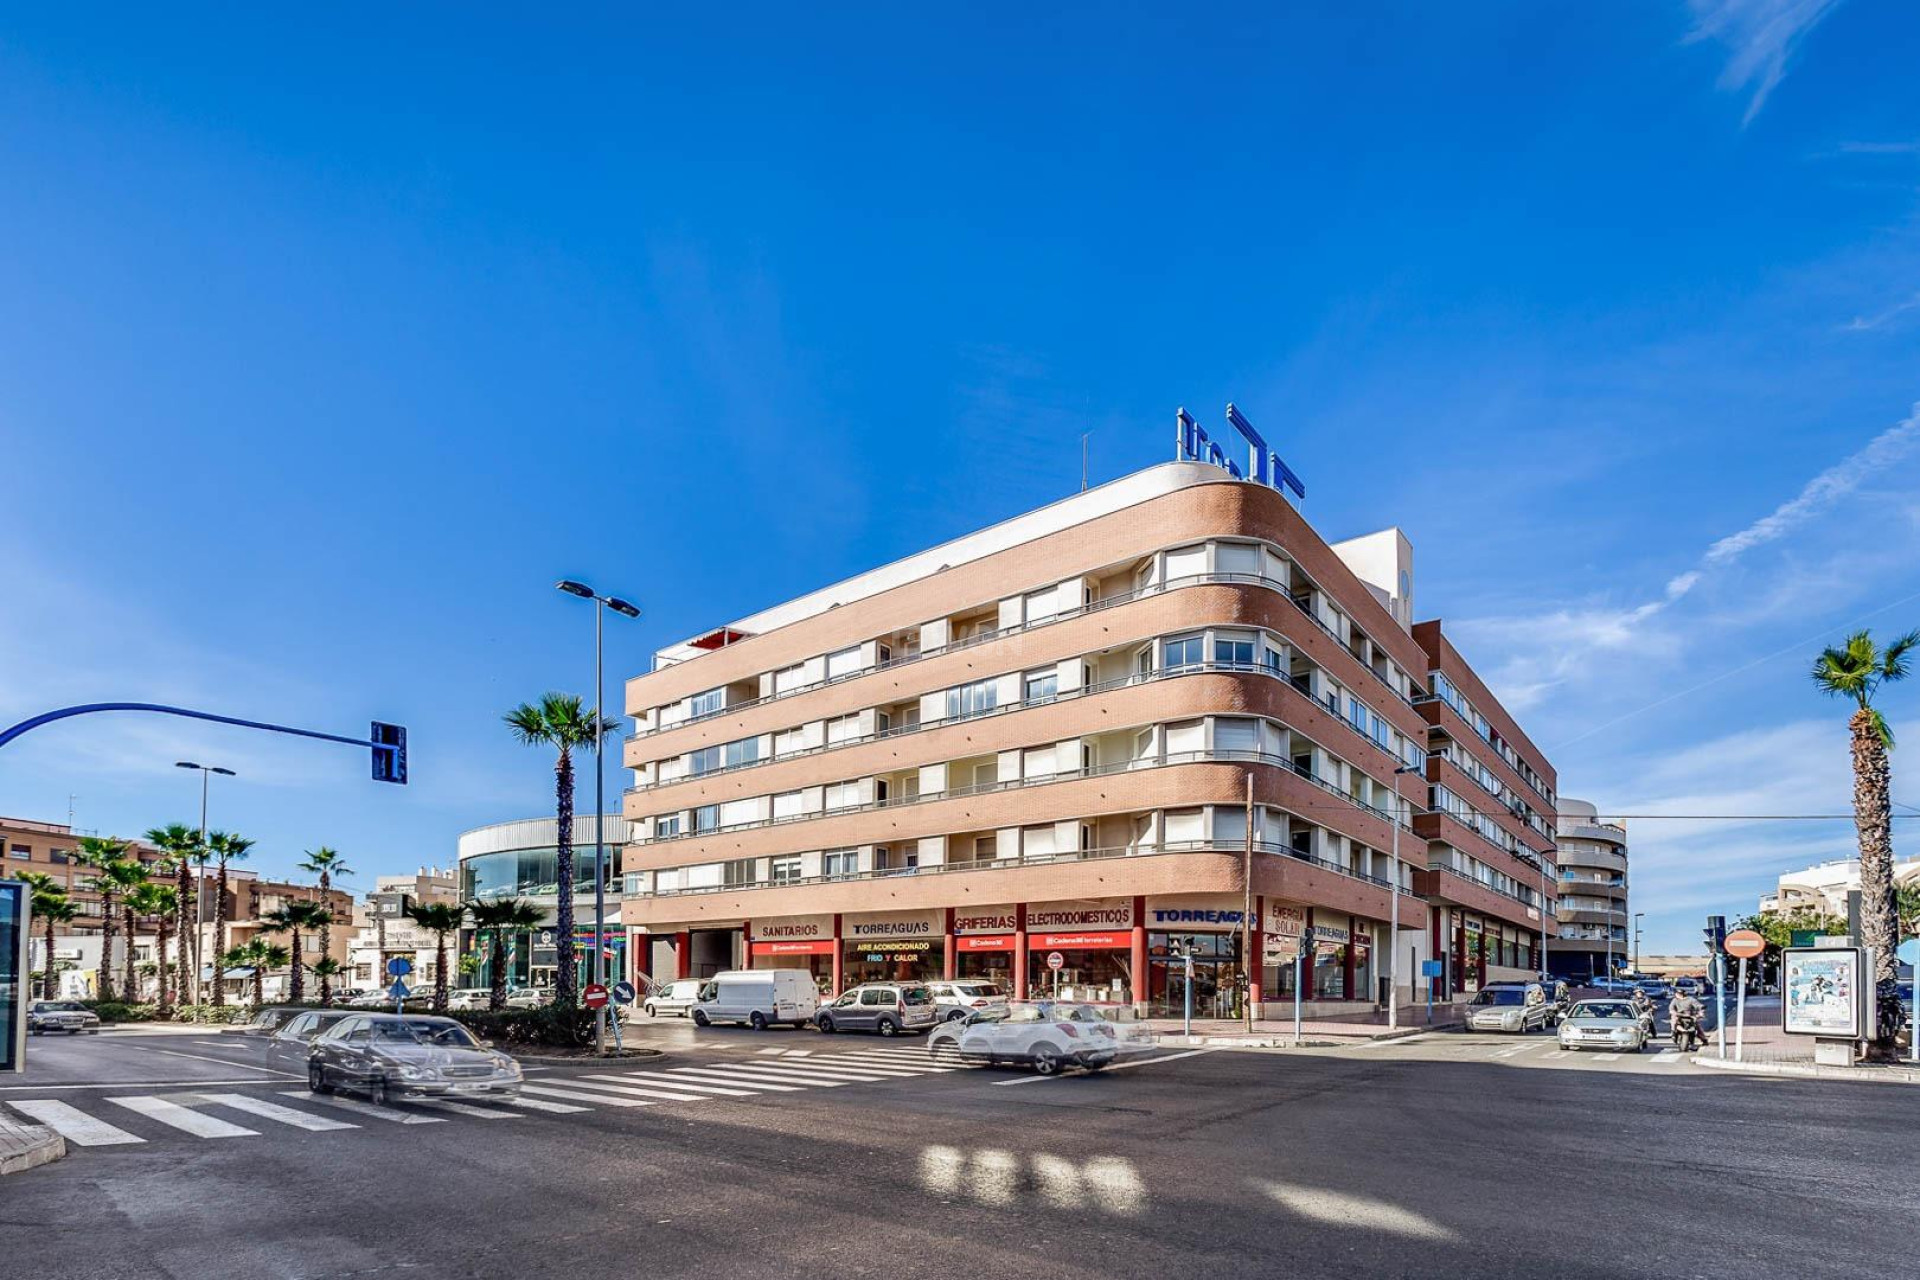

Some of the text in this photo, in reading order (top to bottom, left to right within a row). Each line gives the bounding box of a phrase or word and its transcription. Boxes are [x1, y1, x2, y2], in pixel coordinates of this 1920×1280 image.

[955, 915, 1016, 929] GRIFERIAS
[1027, 909, 1129, 926] ELECTRODOMESTICOS
[762, 924, 819, 937] SANITARIOS
[853, 921, 929, 936] TORREAGUAS
[857, 942, 930, 951] AIRE ACONDICIONADO
[867, 953, 919, 962] FRIO Y CALOR
